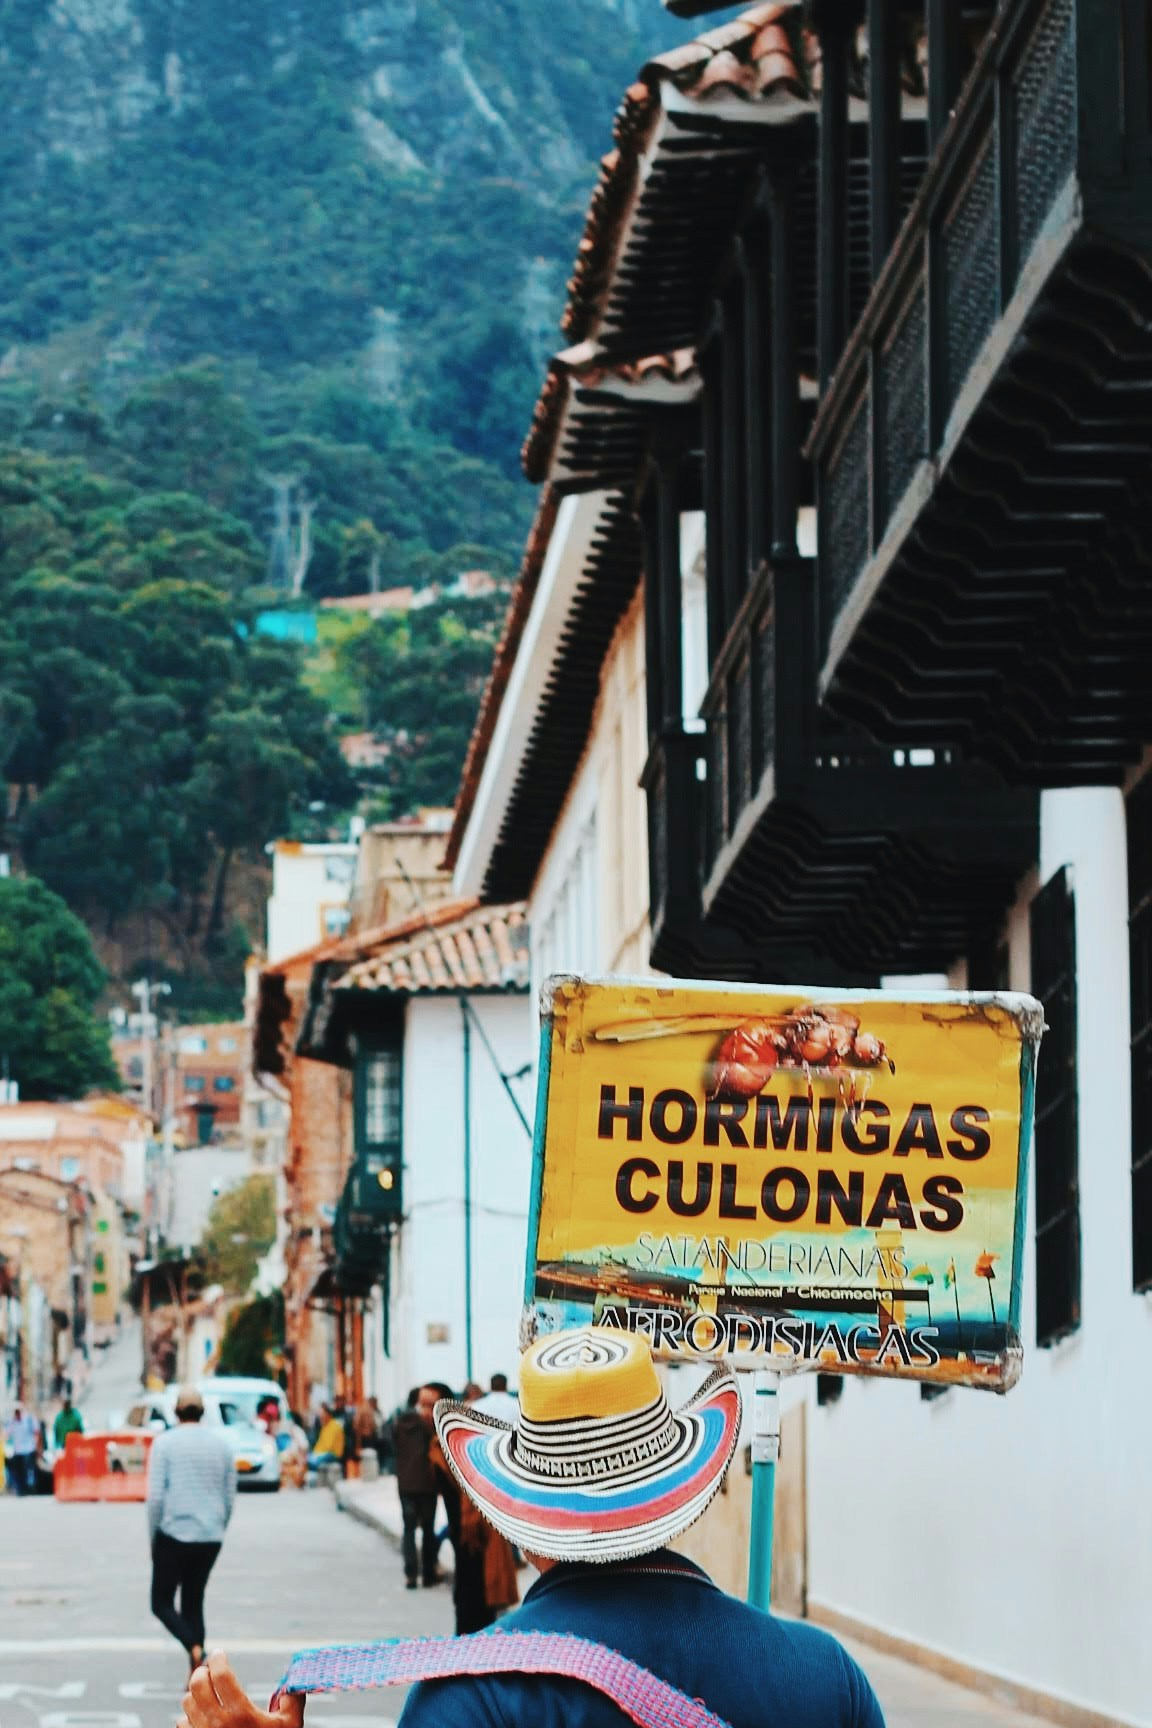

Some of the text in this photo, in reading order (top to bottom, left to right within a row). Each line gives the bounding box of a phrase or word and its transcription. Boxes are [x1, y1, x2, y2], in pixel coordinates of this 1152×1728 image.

[597, 1084, 992, 1161] HORMIGAS
[615, 1157, 965, 1232] CULONAS
[635, 1231, 909, 1280] SATANDERIANAS
